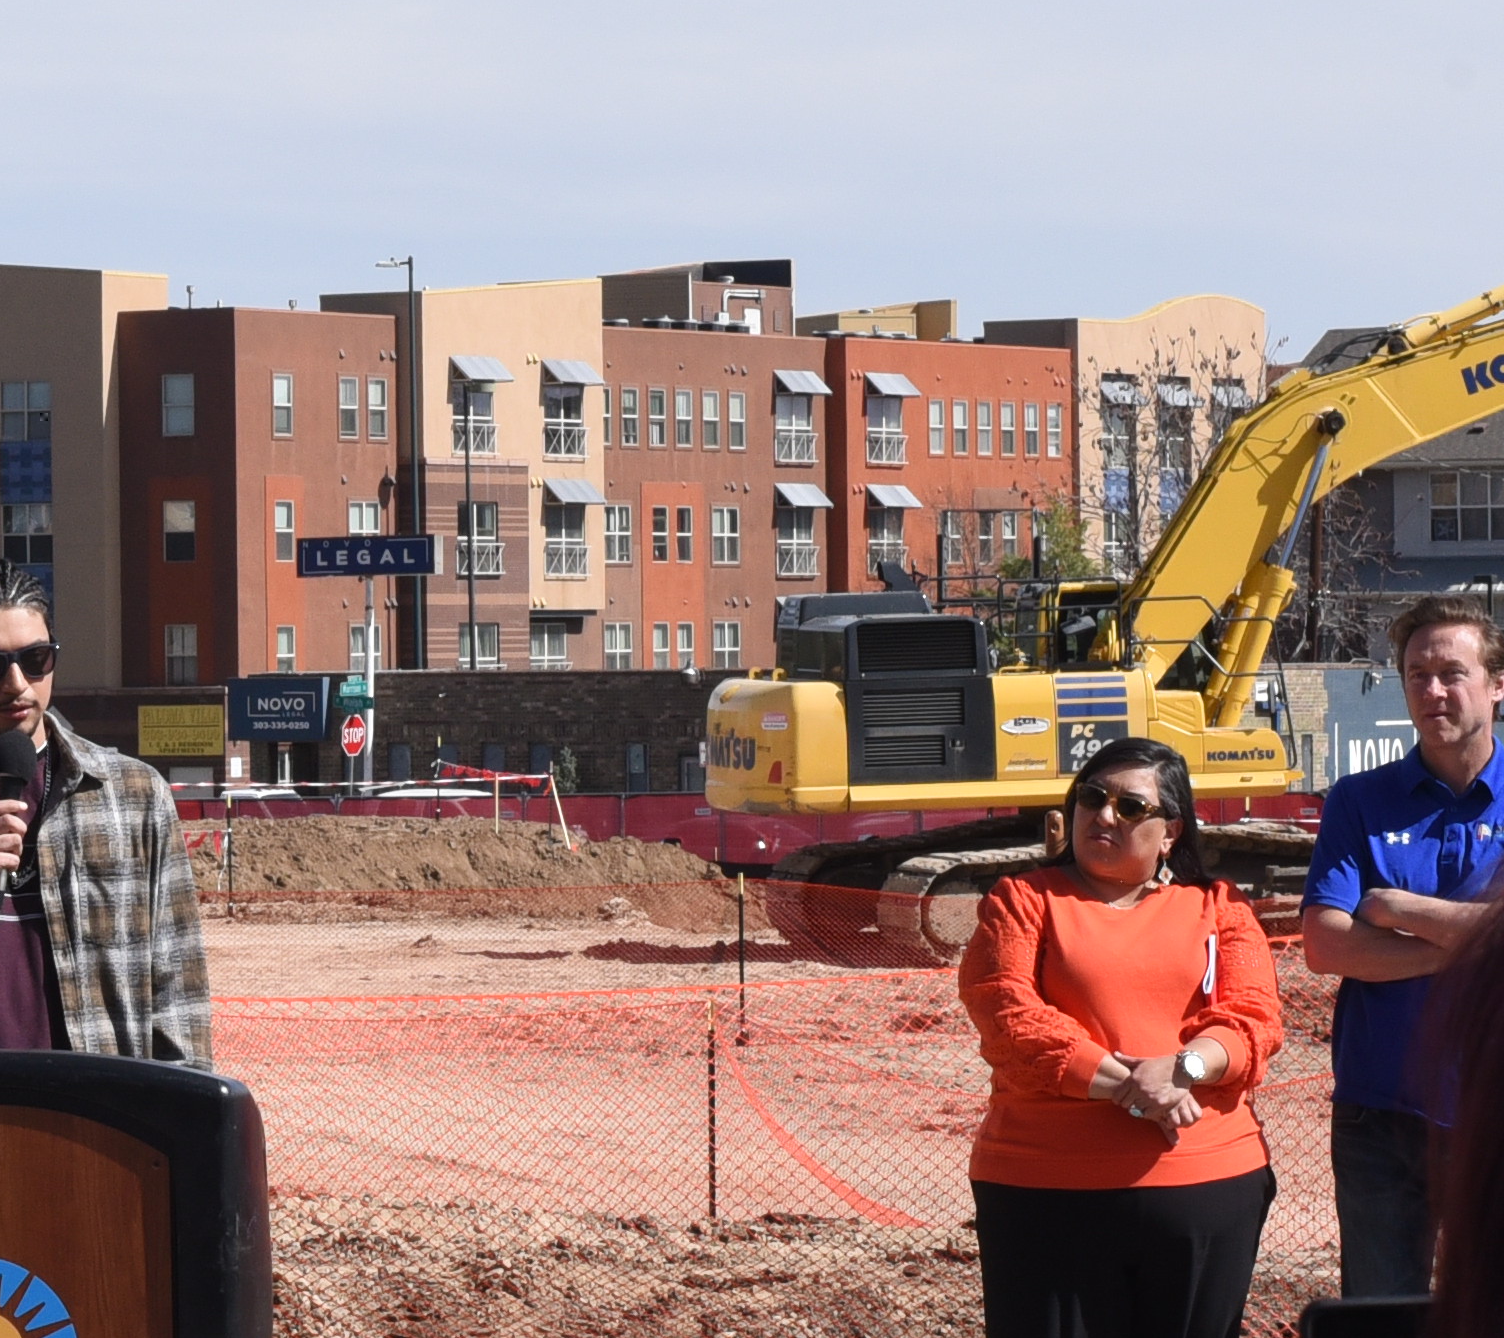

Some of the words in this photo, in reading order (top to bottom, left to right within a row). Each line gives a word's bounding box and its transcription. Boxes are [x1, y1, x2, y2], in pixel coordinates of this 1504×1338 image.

[303, 540, 371, 548] NOVO
[316, 548, 415, 566] LEGAL
[257, 698, 305, 711] NOVO
[253, 721, 310, 729] 303-335-0250
[1070, 724, 1095, 738] PC
[344, 728, 364, 744] STOP
[1207, 746, 1275, 762] KOMATSU
